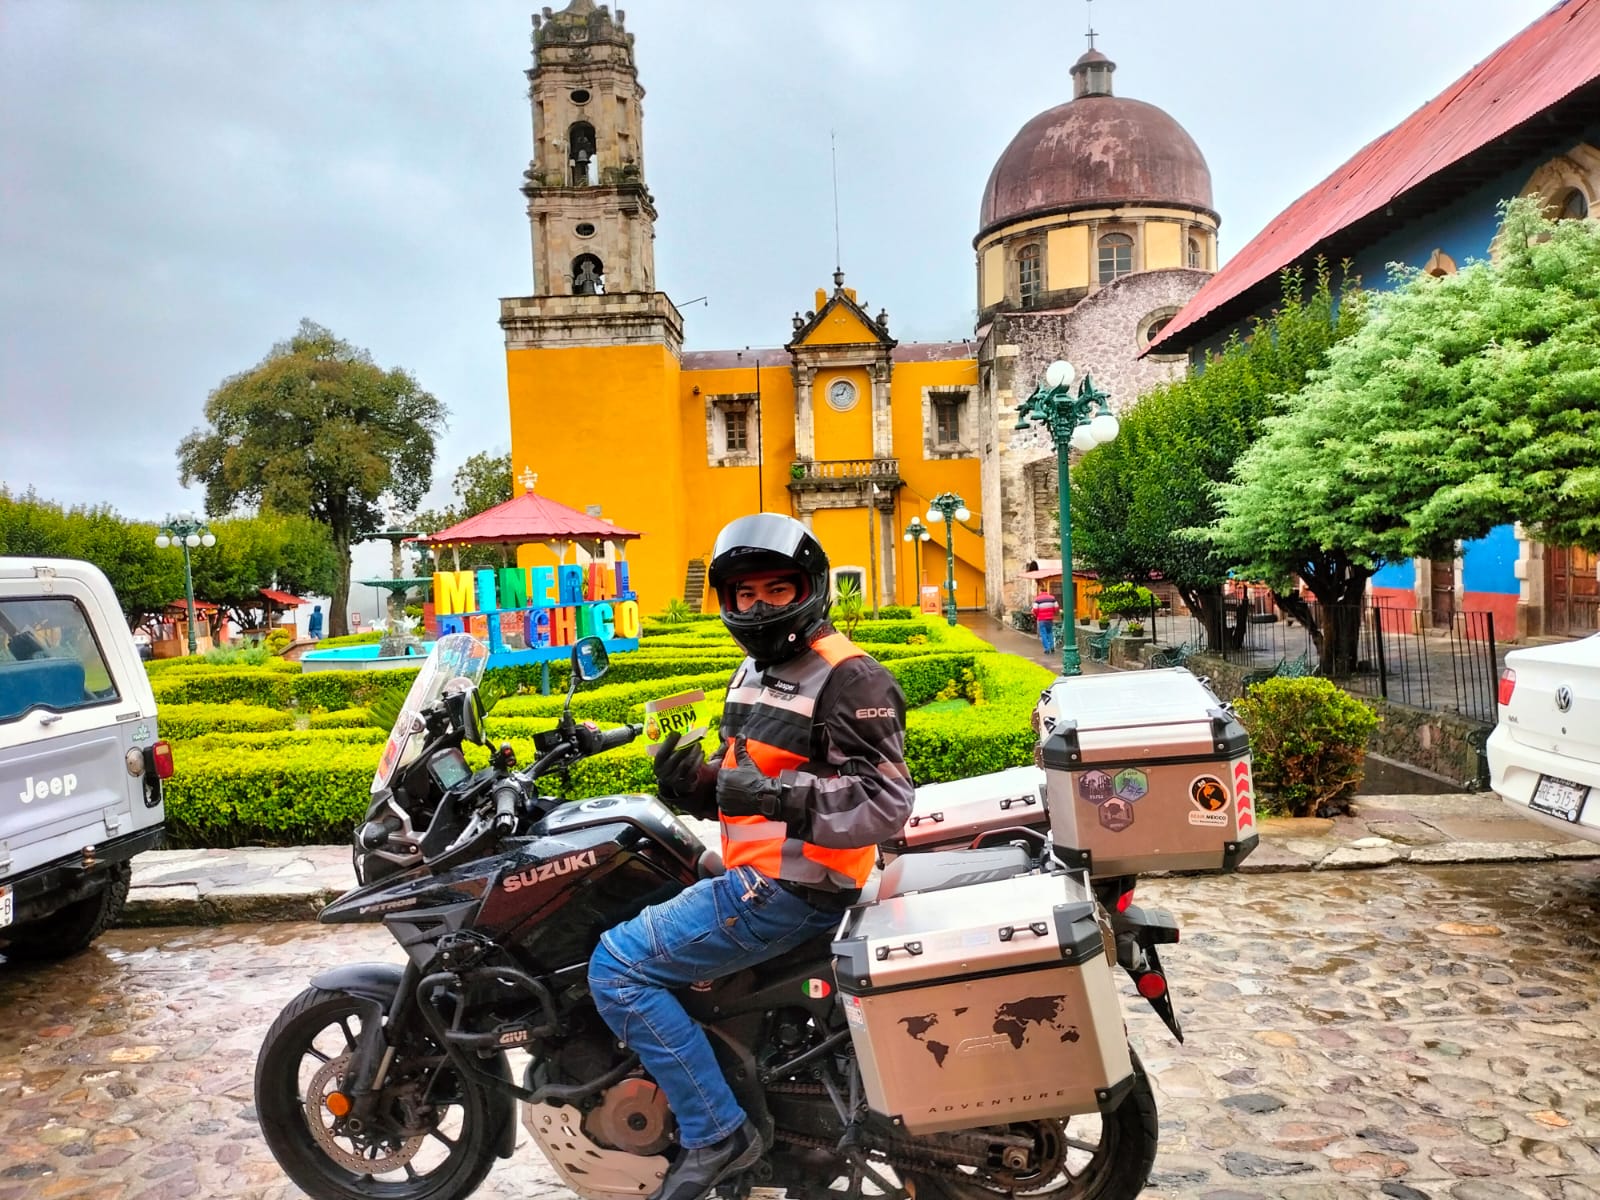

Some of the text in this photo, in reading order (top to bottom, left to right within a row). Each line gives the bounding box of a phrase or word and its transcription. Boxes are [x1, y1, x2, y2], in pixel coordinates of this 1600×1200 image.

[434, 561, 636, 615] MINERAL
[524, 600, 639, 649] CHICO
[659, 710, 697, 734] RRM
[855, 708, 896, 719] EDGE
[19, 773, 78, 804] Jeep
[503, 850, 597, 893] SUZUKI
[499, 1030, 528, 1044] GIVI
[928, 1089, 1065, 1113] ADVENTURE
